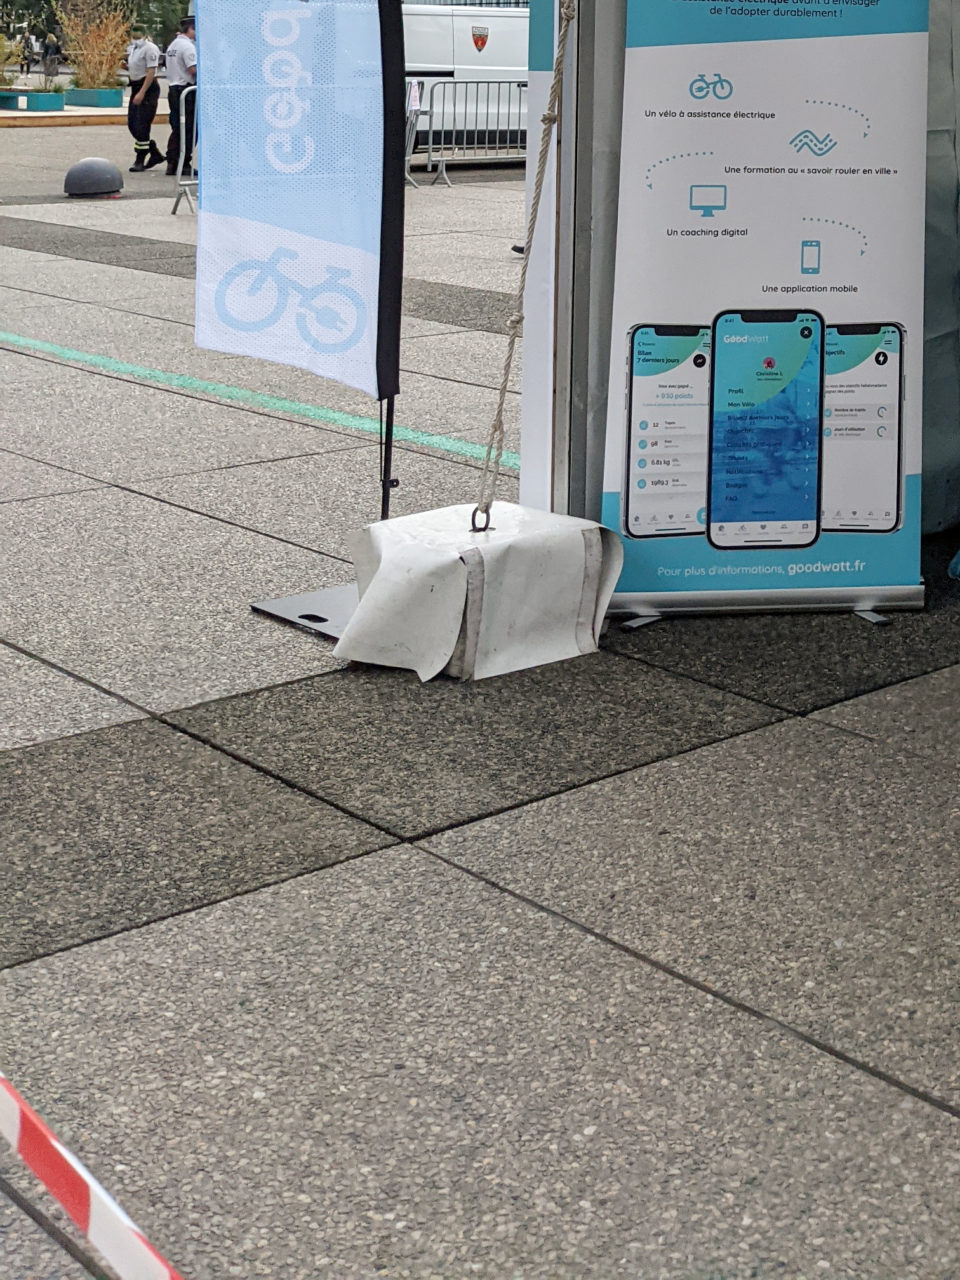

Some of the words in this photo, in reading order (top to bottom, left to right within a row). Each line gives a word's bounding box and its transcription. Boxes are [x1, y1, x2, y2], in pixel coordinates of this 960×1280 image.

[709, 5, 722, 15] de
[725, 6, 771, 17] l'adopter
[773, 7, 837, 17] durablement
[839, 9, 843, 18] !
[644, 110, 657, 118] Un
[659, 109, 677, 118] vélo
[679, 110, 685, 118] à
[686, 110, 731, 119] assistance
[733, 110, 776, 120] électrique
[724, 166, 741, 174] Une
[743, 165, 785, 174] formation
[807, 166, 832, 175] savoir
[835, 166, 860, 175] rouler
[874, 166, 891, 175] ville
[666, 228, 678, 236] Un
[680, 228, 719, 237] coaching
[721, 228, 748, 237] digital
[761, 284, 778, 293] Une
[780, 284, 828, 294] application
[829, 284, 858, 293] mobile
[657, 566, 681, 576] Pour
[684, 565, 706, 578] plus
[708, 563, 785, 576] d'informations,
[787, 559, 866, 576] goodwatt.fr
